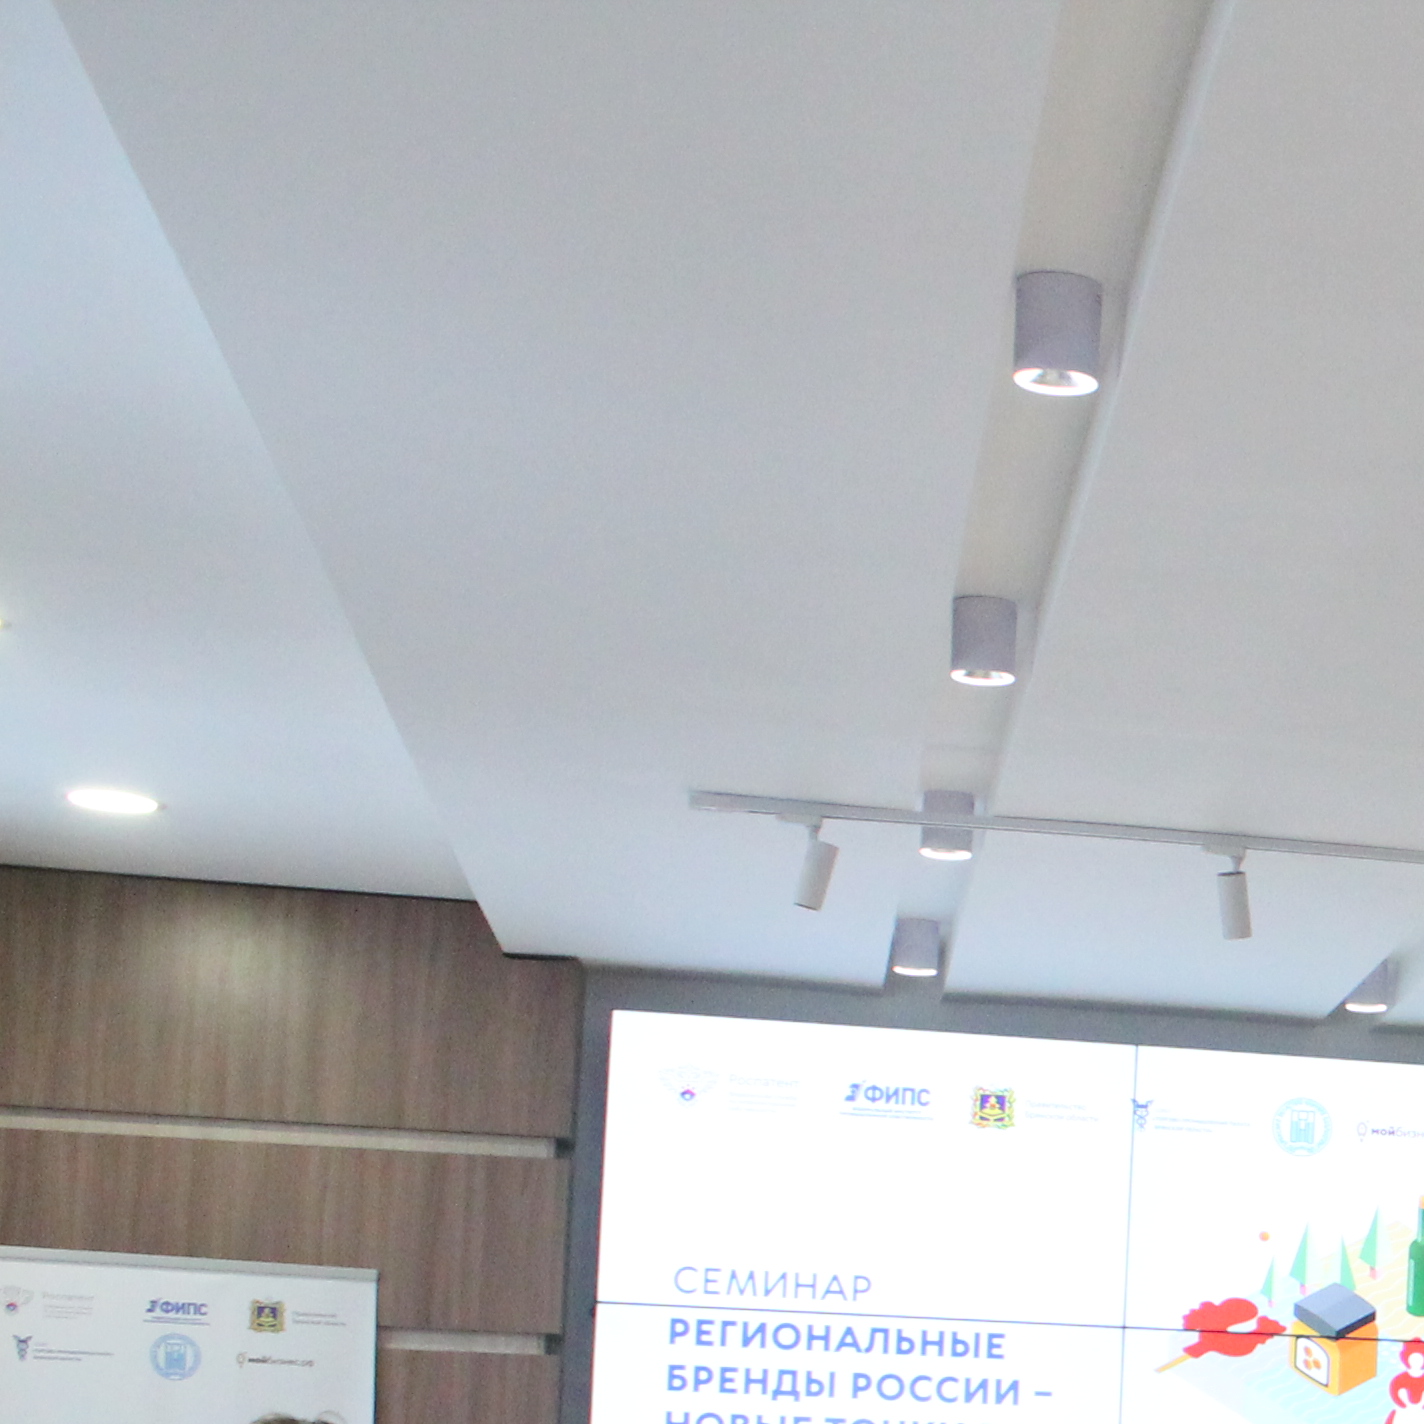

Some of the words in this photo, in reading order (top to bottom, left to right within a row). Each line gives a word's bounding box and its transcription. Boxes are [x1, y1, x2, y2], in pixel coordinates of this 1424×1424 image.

[863, 1084, 931, 1107] ФИПС
[673, 1265, 873, 1301] СЕМИНАР
[160, 1300, 209, 1317] ФИПС
[668, 1317, 1006, 1360] РЕГИОНАЛЬНЫЕ
[666, 1364, 836, 1401] БРЕНДЫ
[851, 1372, 1020, 1406] РОССИИ
